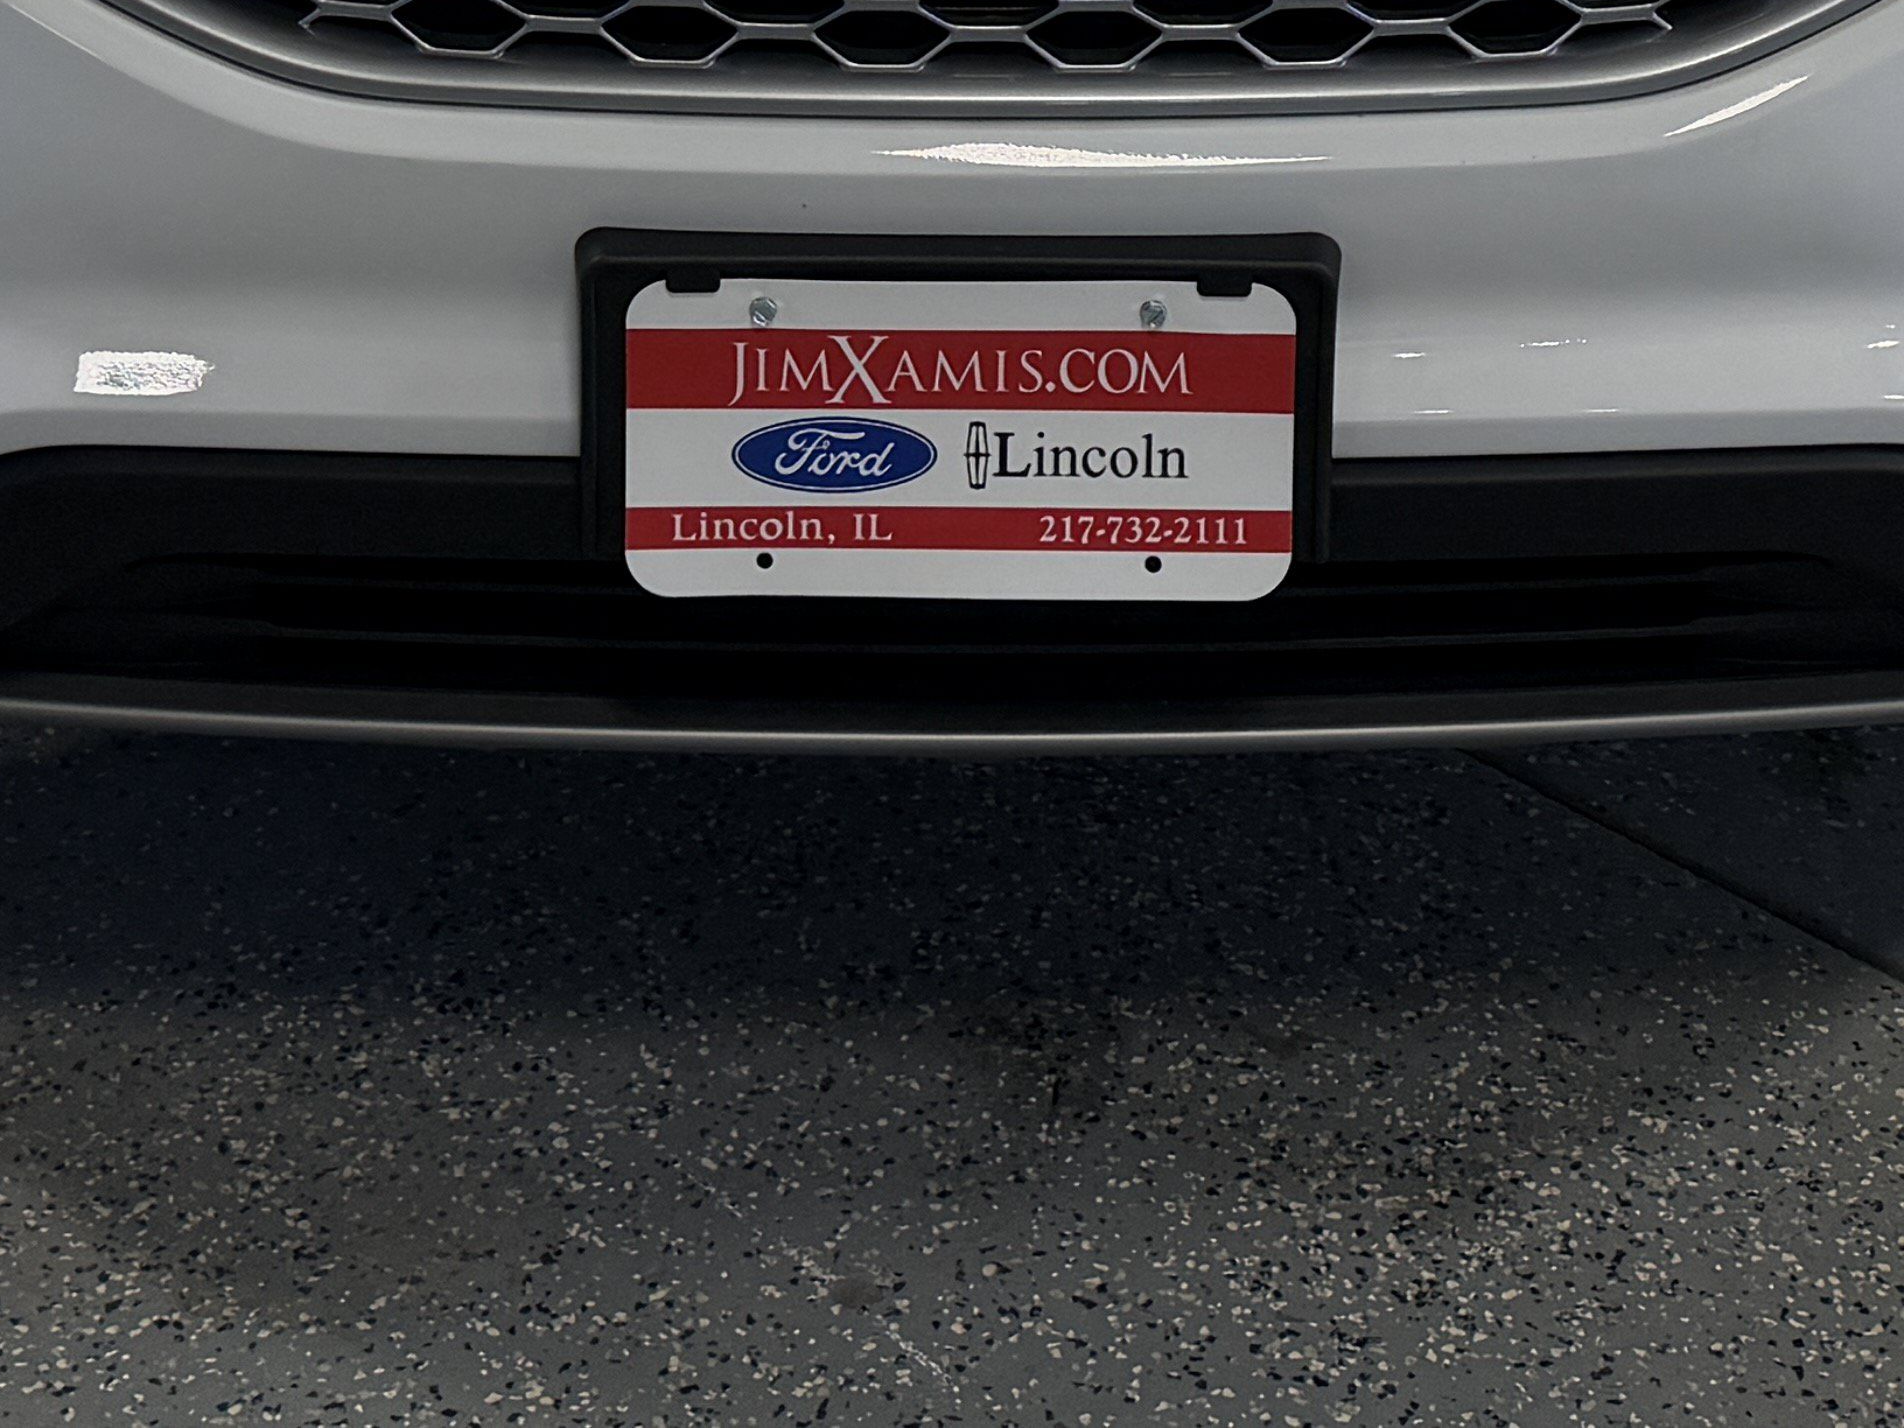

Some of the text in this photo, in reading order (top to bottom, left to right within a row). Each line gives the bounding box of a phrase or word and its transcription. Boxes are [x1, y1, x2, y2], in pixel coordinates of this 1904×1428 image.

[728, 335, 1192, 406] JIMXAMIS.COM
[774, 428, 893, 478] Ford
[993, 431, 1188, 479] Lincoln
[672, 512, 893, 543] Lincoln, IL
[1039, 516, 1247, 545] 217-732-2111
